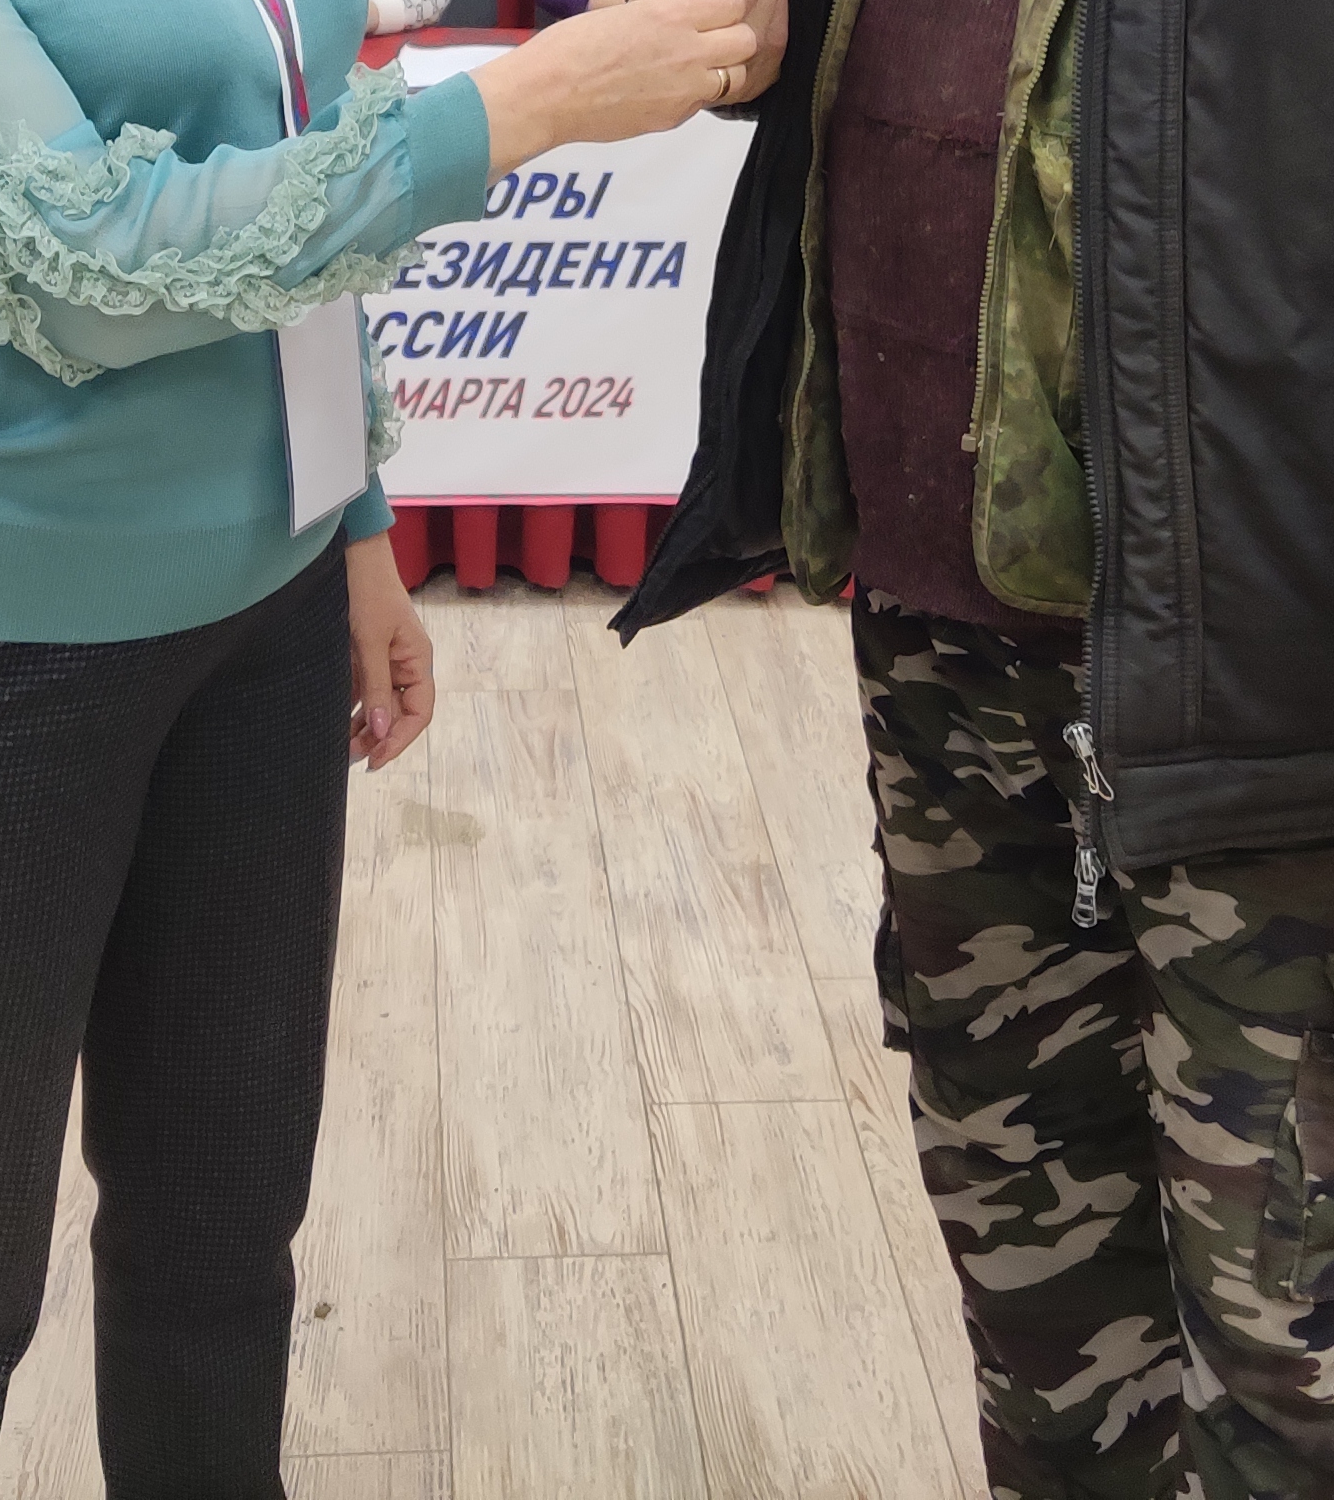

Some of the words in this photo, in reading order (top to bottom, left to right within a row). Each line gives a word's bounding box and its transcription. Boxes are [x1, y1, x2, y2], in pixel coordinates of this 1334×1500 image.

[484, 172, 613, 219] ОРЫ
[393, 241, 687, 296] ЕЗИДЕНТА
[365, 311, 528, 359] ССИИ
[393, 377, 525, 419] МАРТА
[533, 376, 634, 418] 2024
